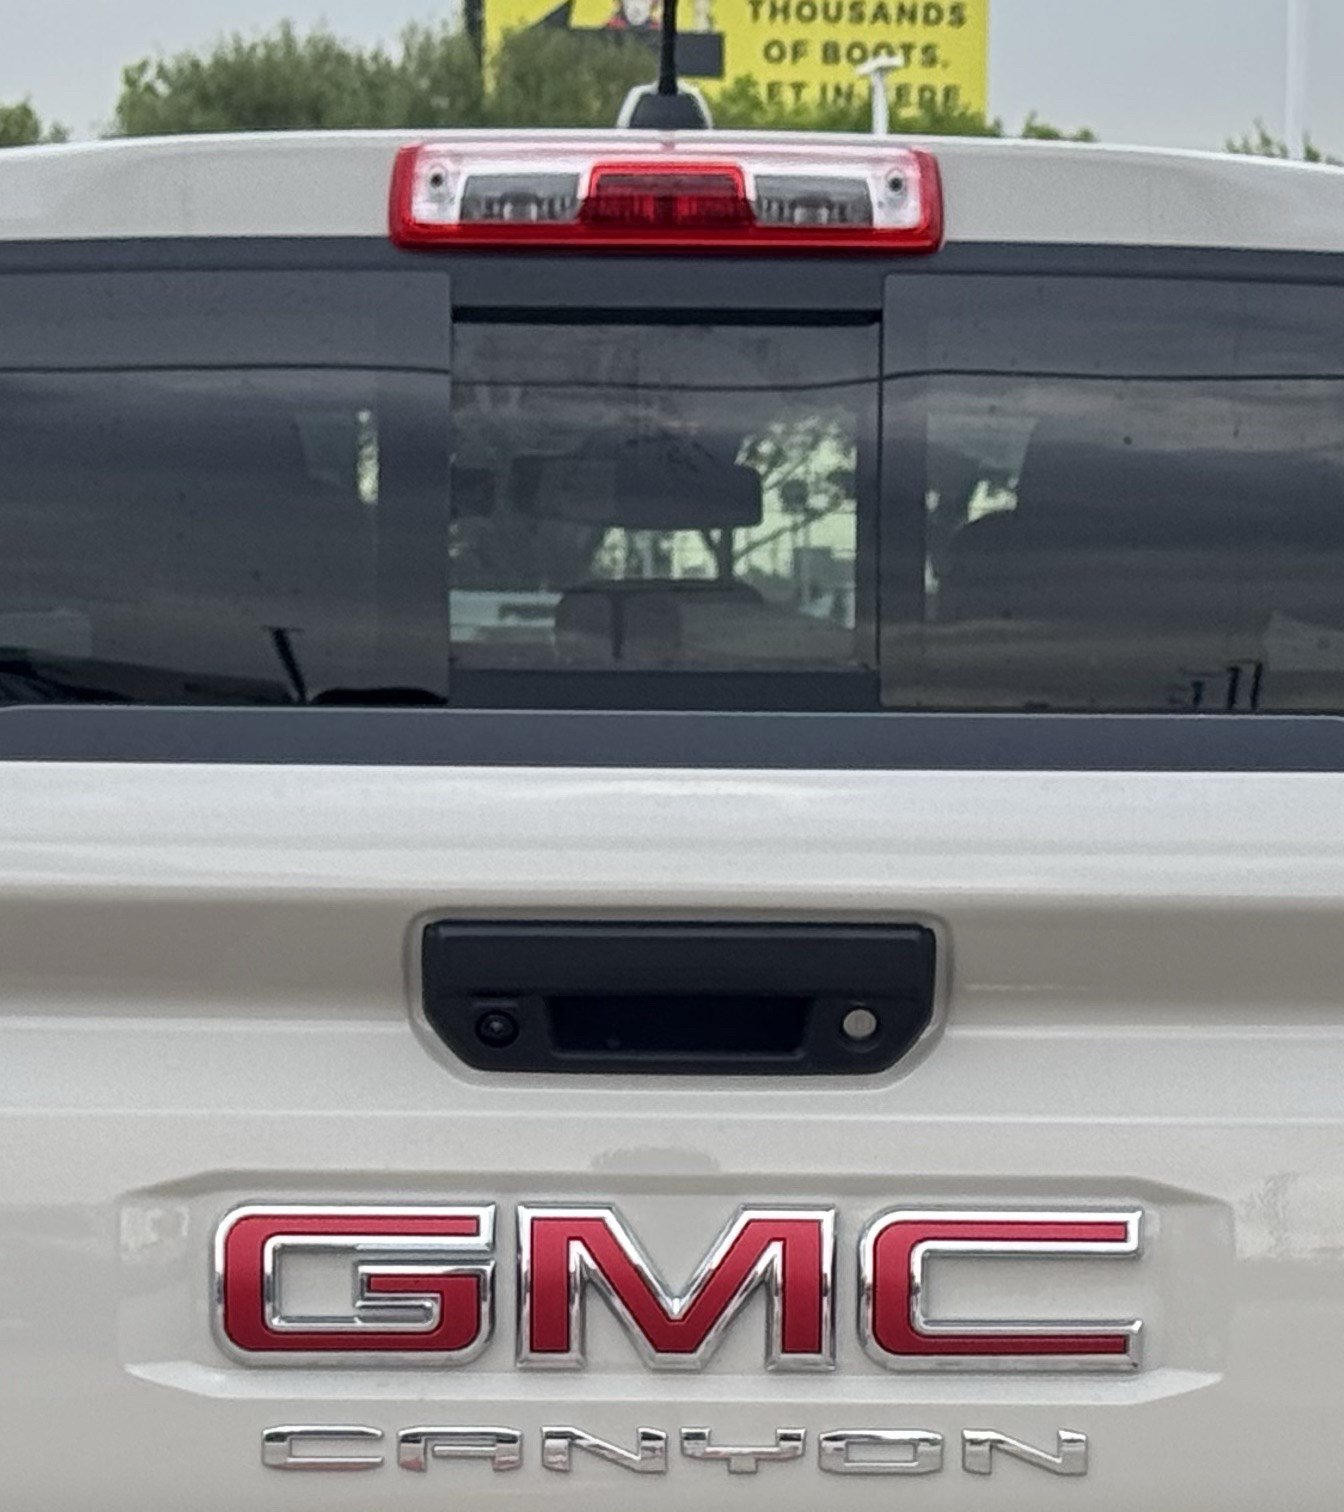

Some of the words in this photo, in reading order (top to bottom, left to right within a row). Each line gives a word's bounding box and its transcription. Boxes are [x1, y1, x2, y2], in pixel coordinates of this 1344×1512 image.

[749, 0, 966, 28] THOUSANDS
[763, 40, 808, 65] OF
[214, 1202, 1144, 1372] GMC
[261, 1423, 1089, 1476] CANYON
